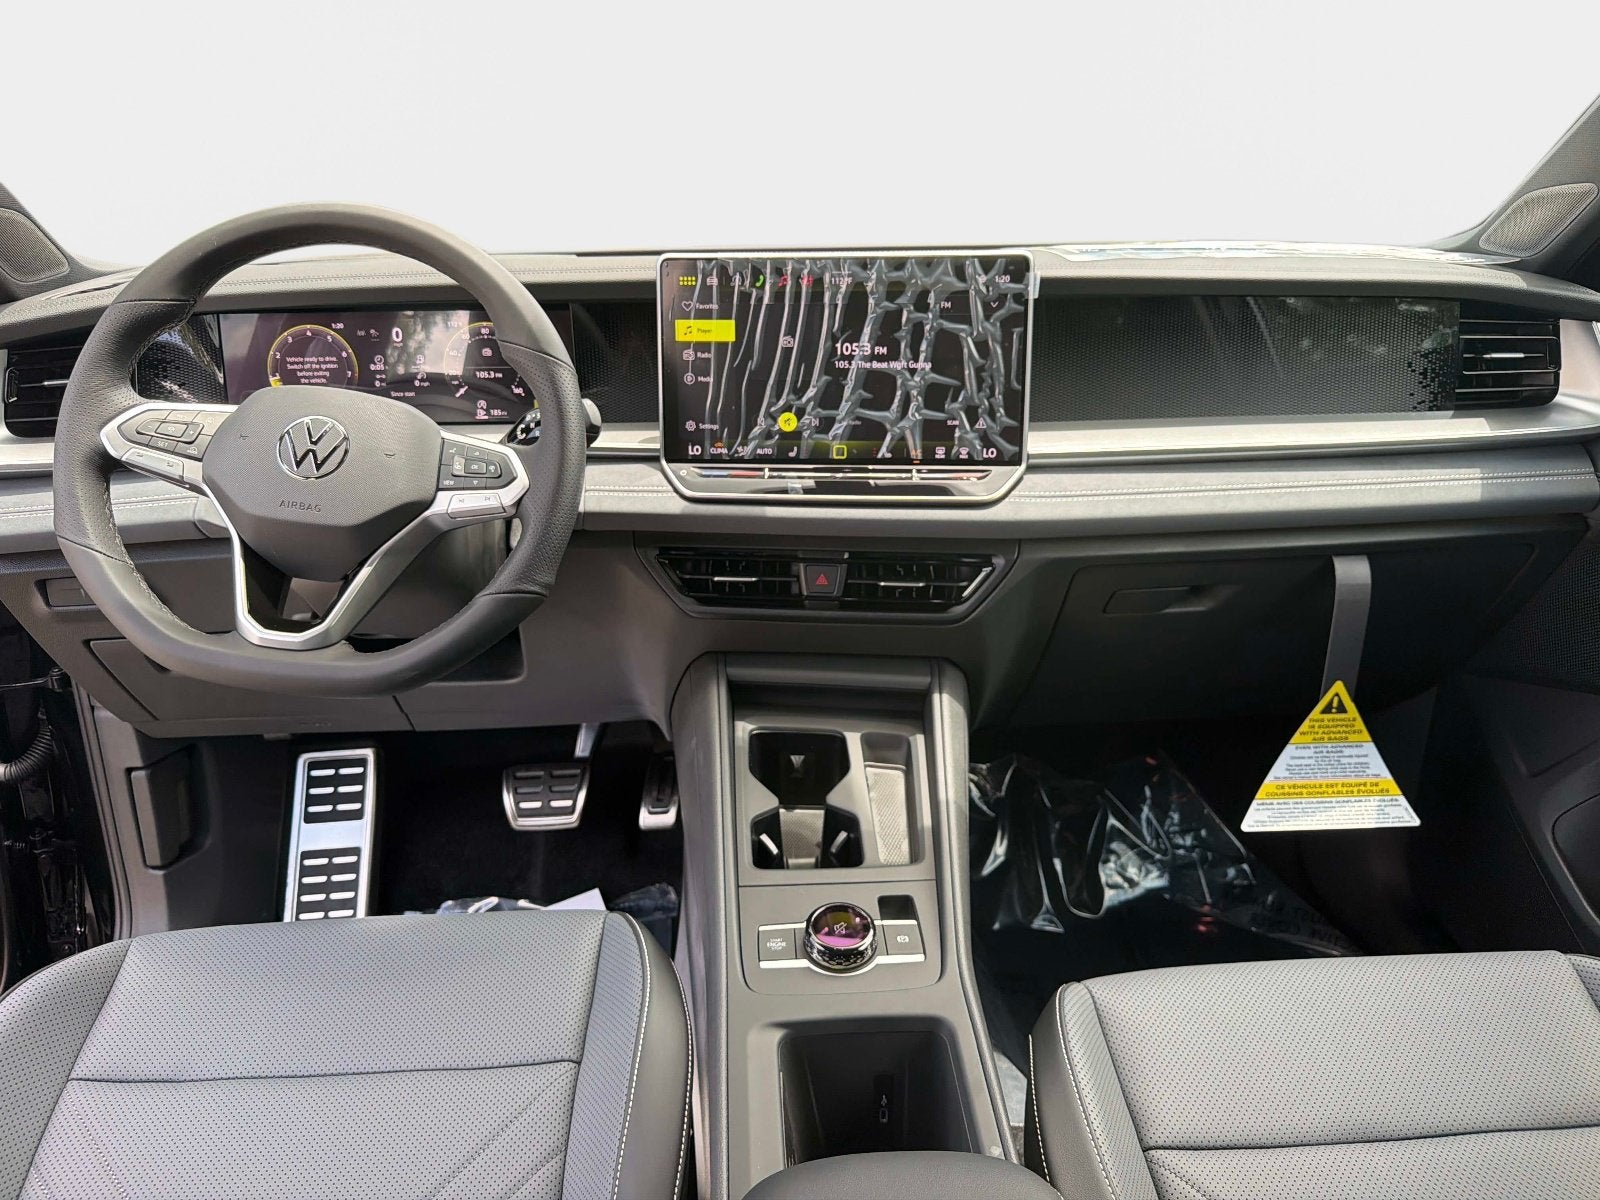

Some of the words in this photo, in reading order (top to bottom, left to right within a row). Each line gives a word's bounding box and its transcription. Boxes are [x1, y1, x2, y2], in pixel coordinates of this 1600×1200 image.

[392, 327, 403, 342] 0
[835, 342, 871, 355] 105.3
[874, 346, 887, 355] FM
[280, 416, 349, 478] VW
[689, 445, 701, 455] LO
[983, 448, 997, 458] LO
[279, 500, 322, 512] AIRBAG
